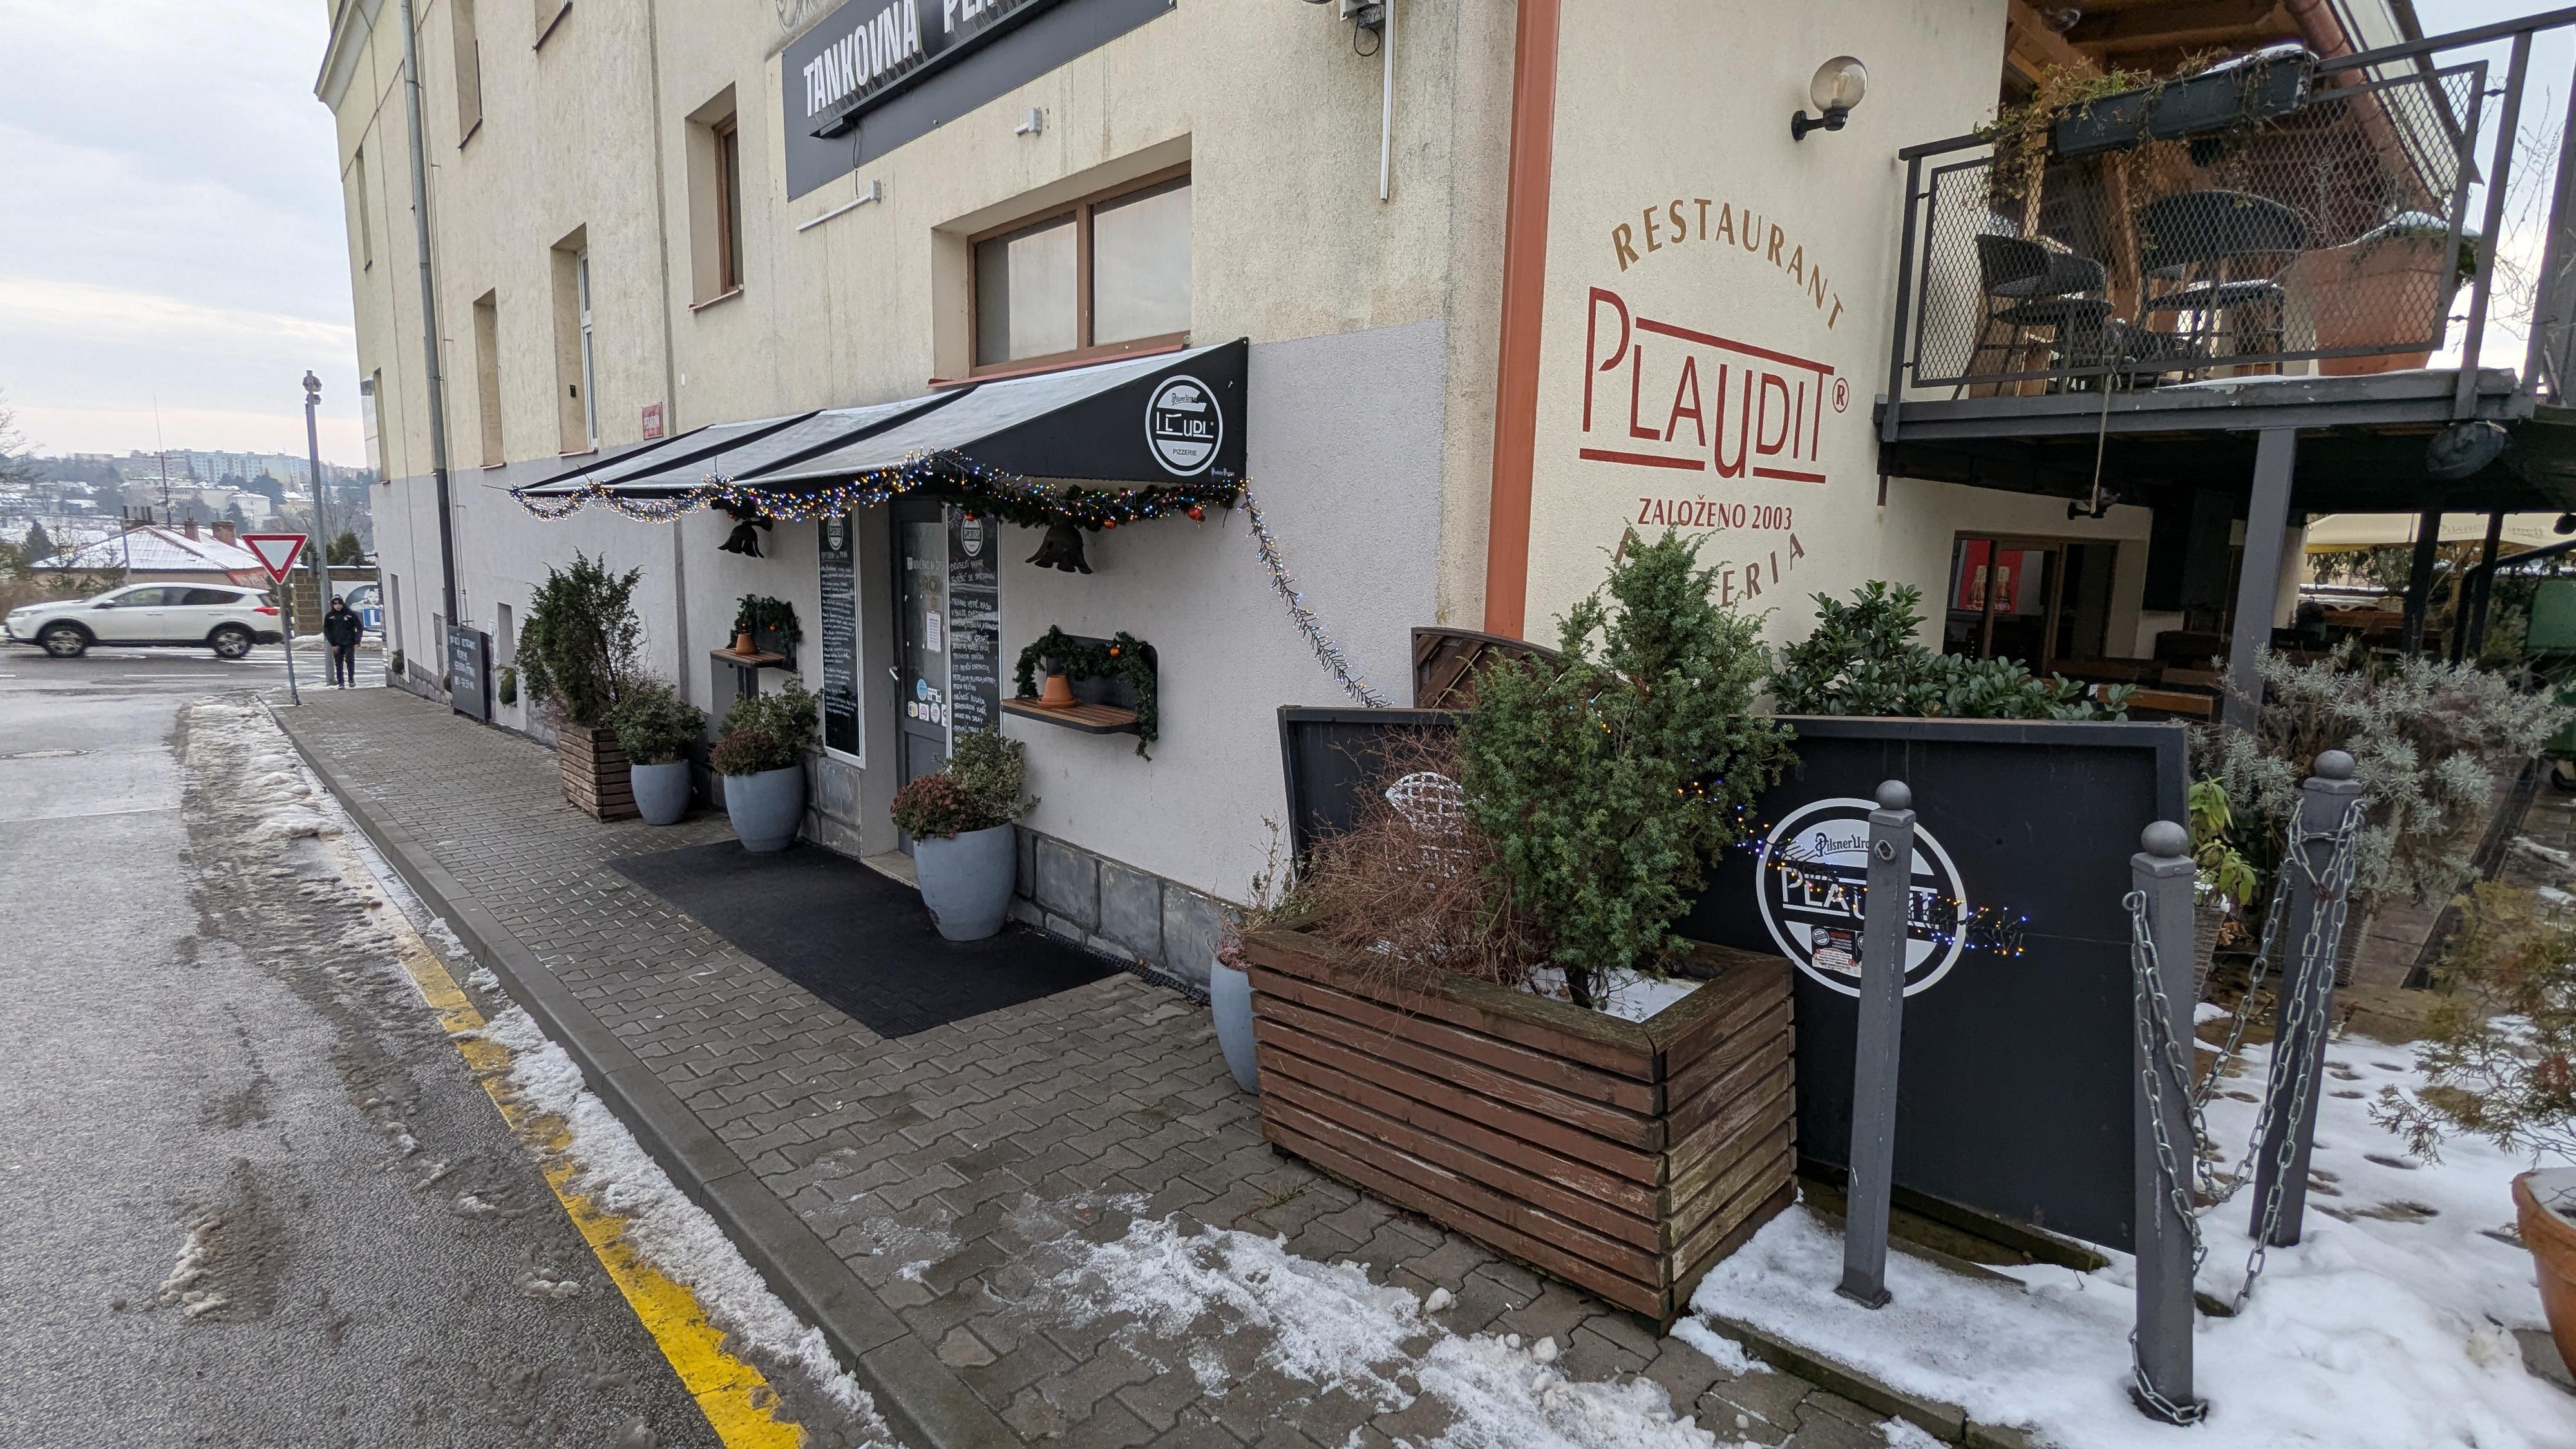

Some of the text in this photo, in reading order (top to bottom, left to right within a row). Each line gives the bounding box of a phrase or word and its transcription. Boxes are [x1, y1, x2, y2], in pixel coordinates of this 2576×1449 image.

[803, 0, 920, 118] TANKOVNA
[1611, 198, 1844, 330] RESTAURANT
[1172, 448, 1198, 457] PIZZERIE
[1637, 494, 1793, 531] ZALOŽENO 2003
[1815, 832, 1852, 857] Pilsner
